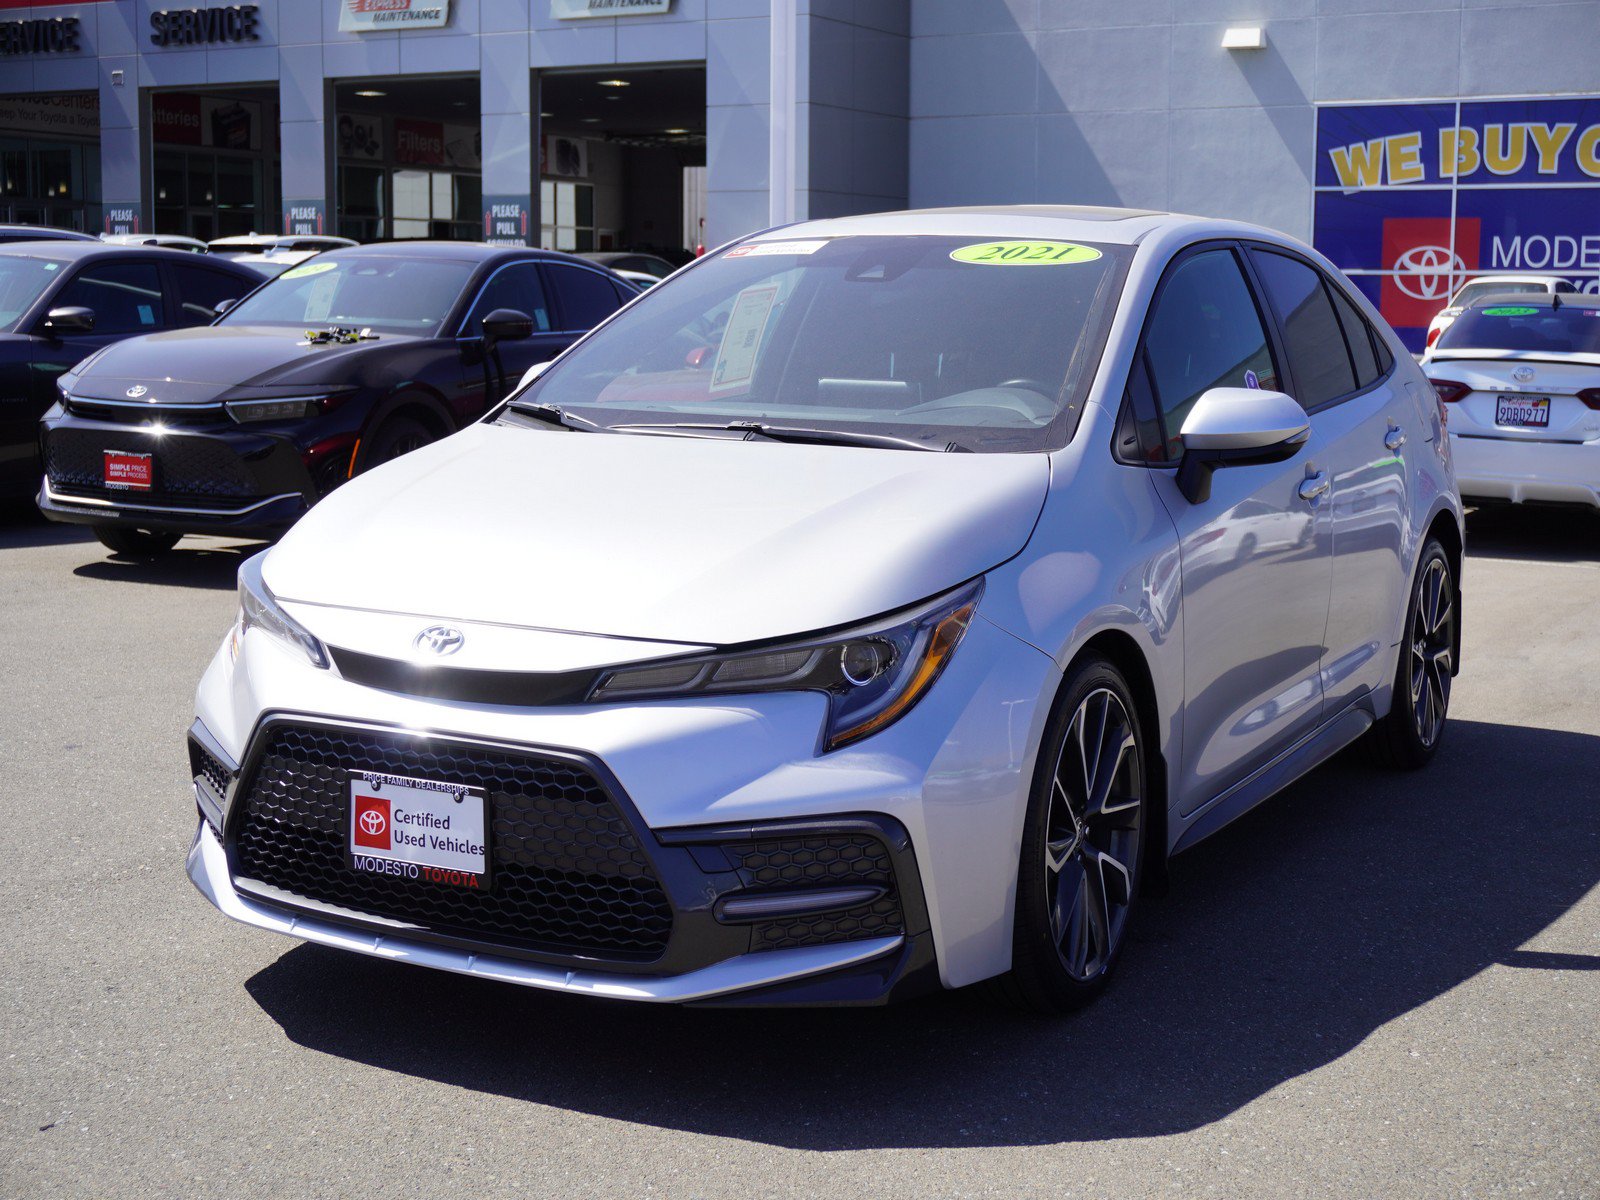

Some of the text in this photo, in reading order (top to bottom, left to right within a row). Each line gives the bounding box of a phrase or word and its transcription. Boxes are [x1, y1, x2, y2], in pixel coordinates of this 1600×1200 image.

[372, 9, 441, 23] MAINTENANCE
[150, 5, 261, 46] SERVICE
[397, 130, 441, 154] Filters
[1328, 131, 1425, 195] WE
[1438, 122, 1577, 178] BUY
[110, 209, 133, 221] PLEASE
[291, 207, 316, 220] PLEASE
[492, 205, 520, 218] PLEASE
[295, 223, 313, 235] PULL
[496, 222, 516, 235] PULL
[973, 245, 1075, 260] 2021
[1491, 235, 1600, 269] MODE
[1500, 406, 1546, 423] 9DBD977
[110, 463, 130, 471] SIMPLE
[363, 772, 470, 796] PRICE FAMILY DEALERSHIPS
[394, 808, 450, 830] Certified
[394, 830, 485, 856] Used Vehicles
[354, 855, 479, 889] MODESTO TOYOTA
